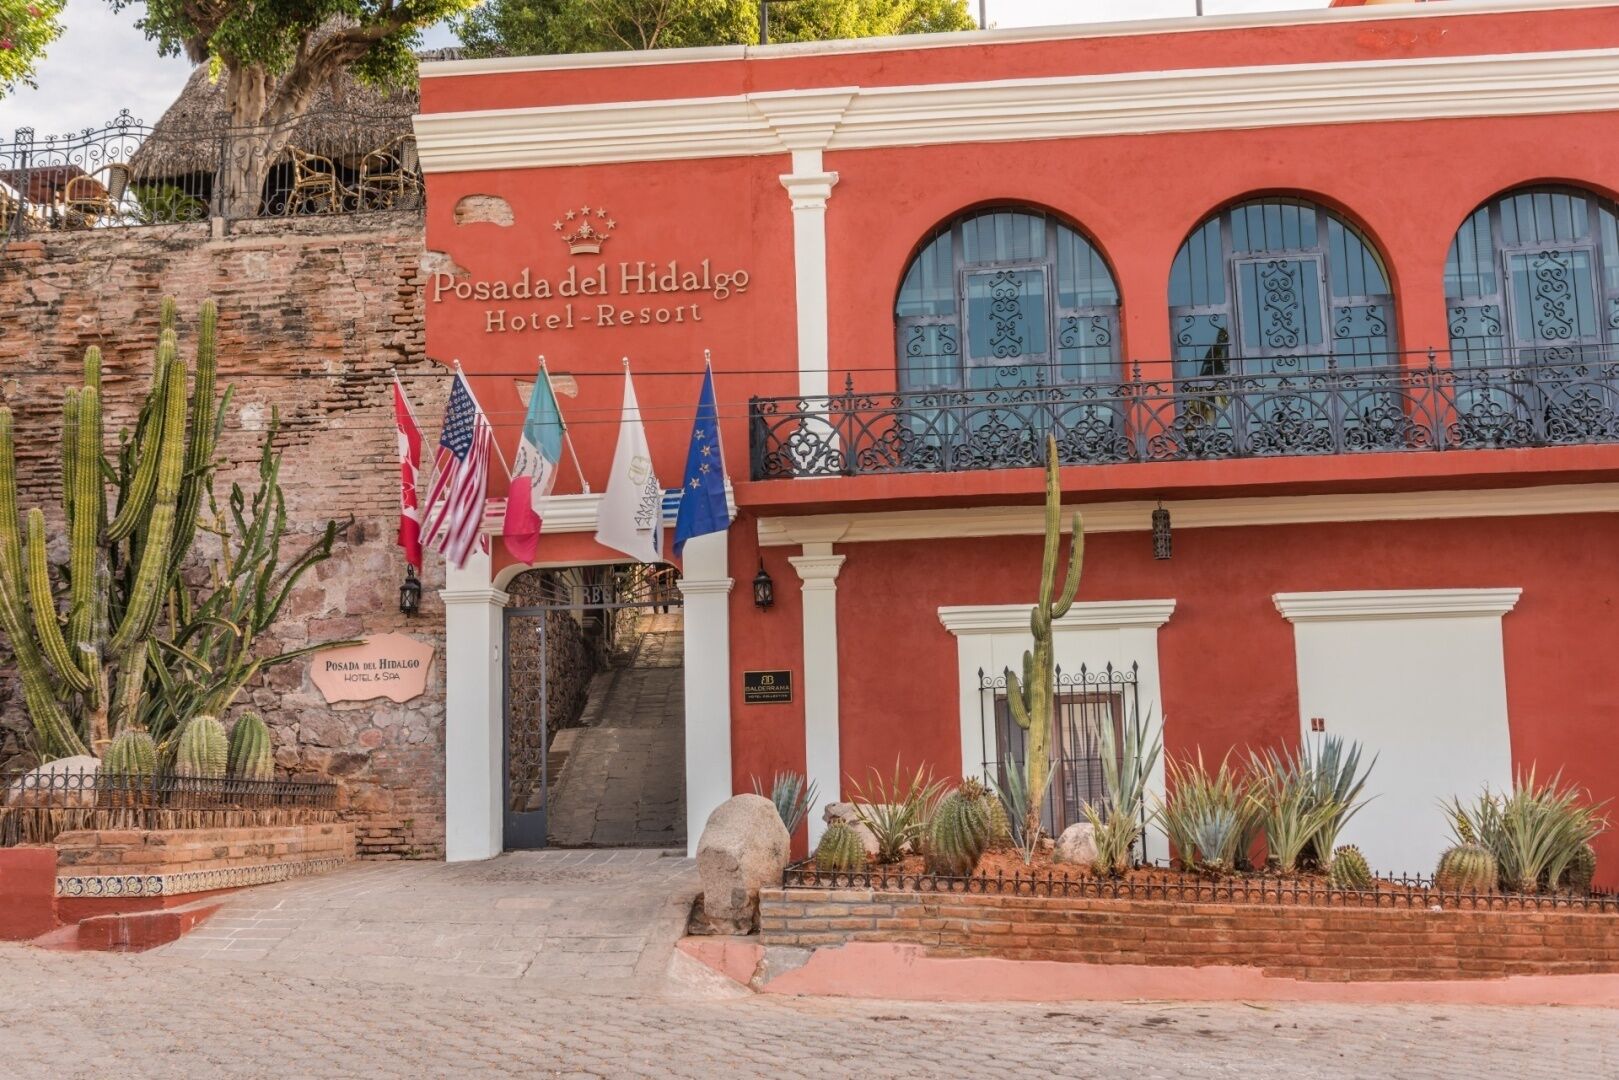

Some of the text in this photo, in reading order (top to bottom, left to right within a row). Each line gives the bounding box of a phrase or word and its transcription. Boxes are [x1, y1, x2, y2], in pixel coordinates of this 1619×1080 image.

[432, 258, 749, 302] Posada del Hidalgo
[325, 659, 420, 671] POSADA DEL HIDALGO
[344, 672, 401, 682] HOTEL & SPA
